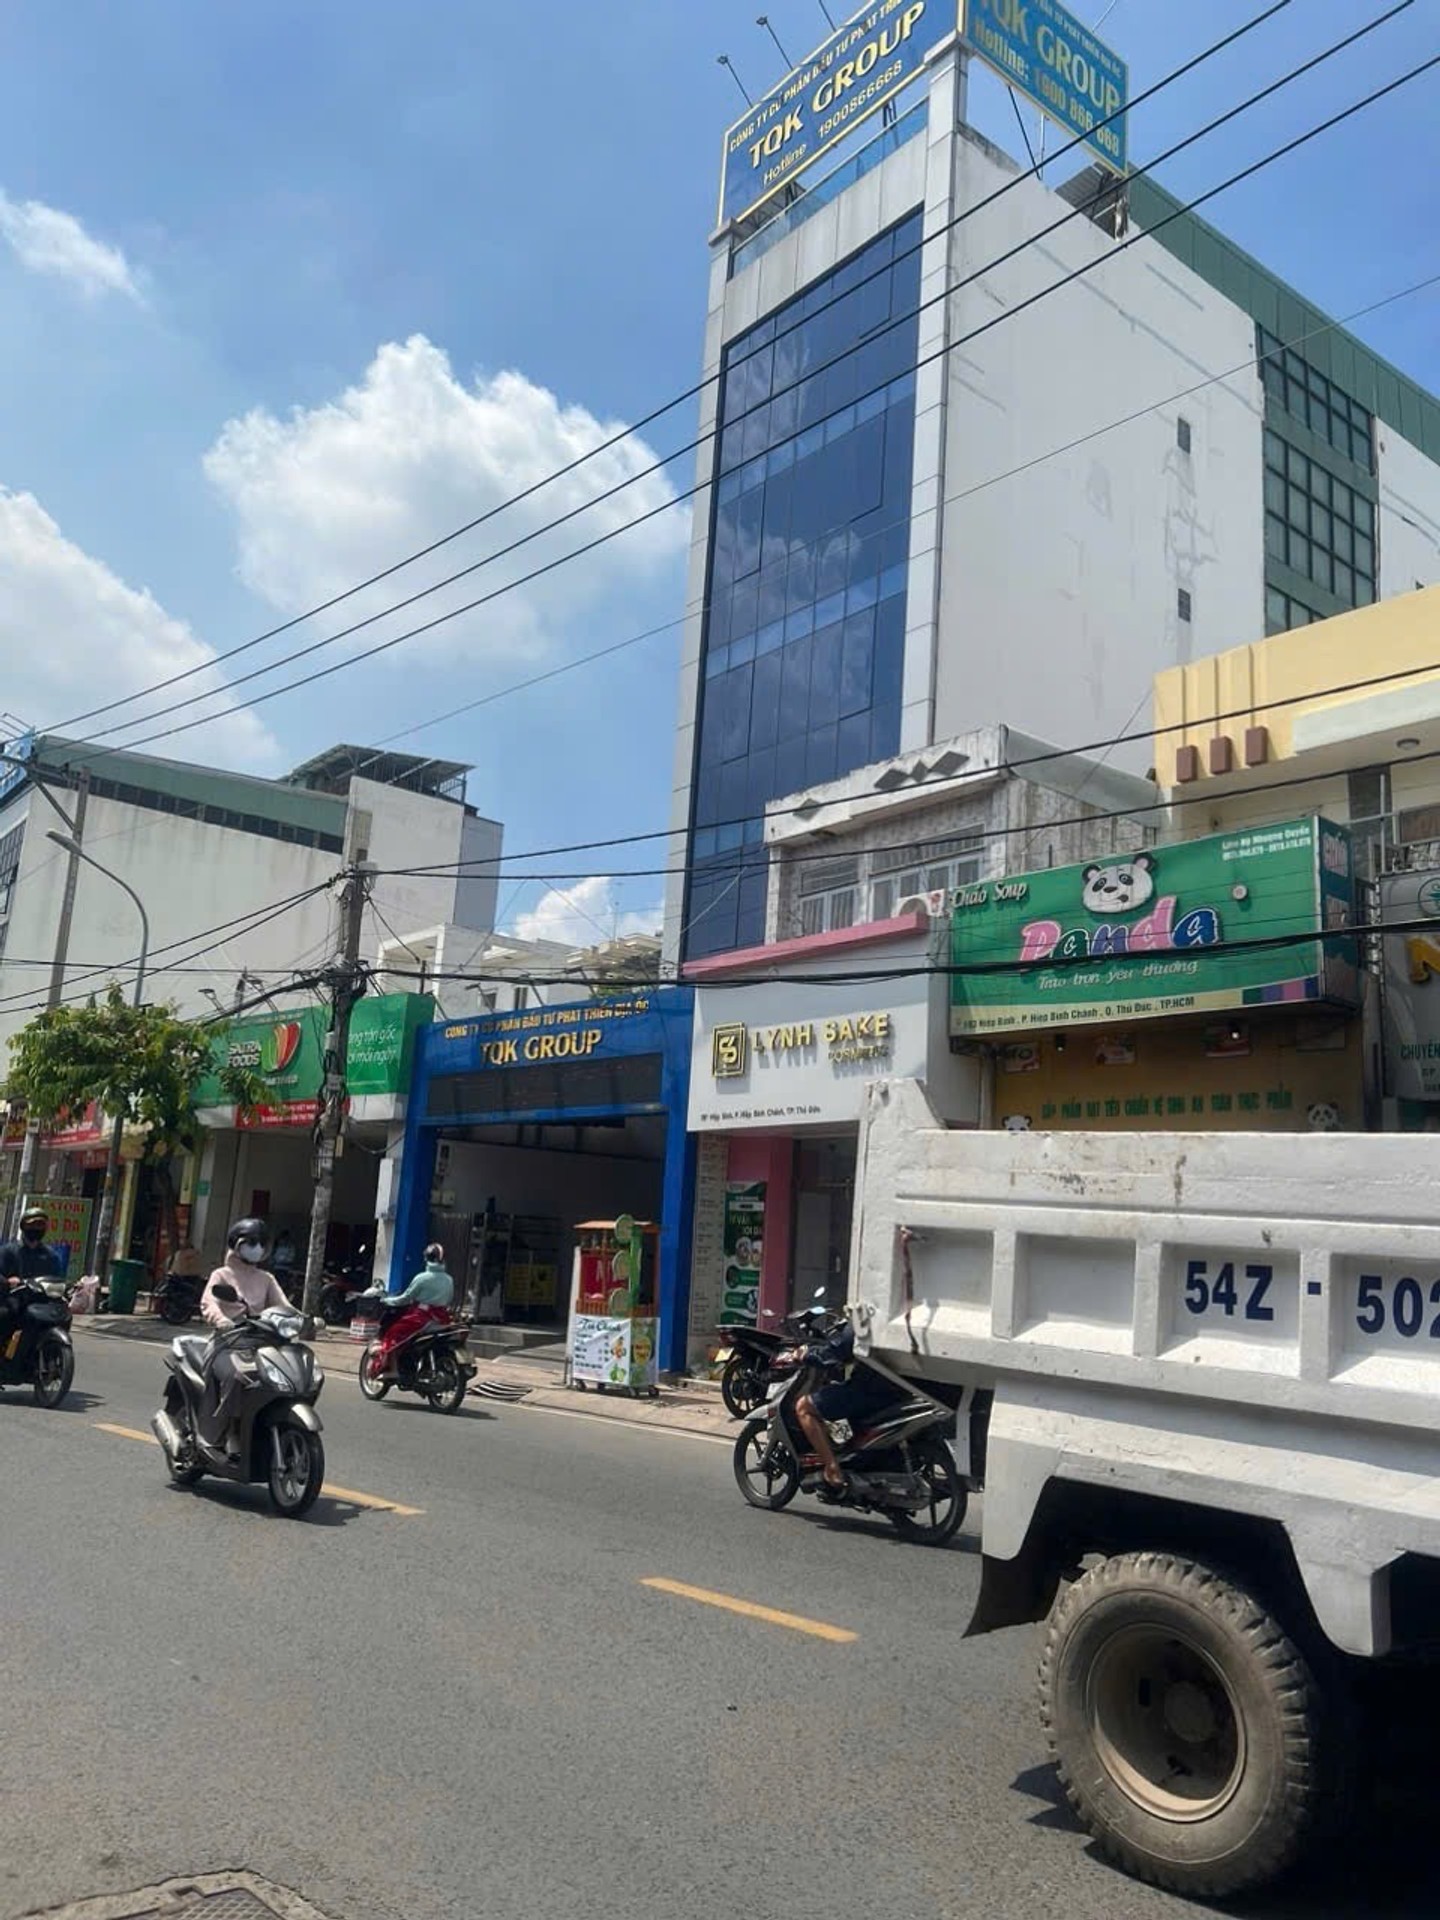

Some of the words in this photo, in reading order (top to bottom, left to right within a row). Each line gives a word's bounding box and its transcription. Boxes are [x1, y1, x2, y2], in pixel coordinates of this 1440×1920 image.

[975, 16, 1029, 83] Hotline:
[1037, 25, 1121, 115] GROUP
[749, 104, 803, 168] TQK
[813, 1, 925, 112] GROUP
[764, 143, 807, 186] Hotline
[993, 880, 1028, 901] Soup
[1020, 895, 1220, 970] Panda
[229, 1040, 262, 1054] SATRA
[482, 1039, 518, 1065] TQK
[524, 1029, 602, 1060] GROUP
[752, 1024, 813, 1052] LYNH
[823, 1013, 890, 1042] SAKE
[229, 1054, 261, 1068] FOODS
[1185, 1261, 1274, 1321] 54Z
